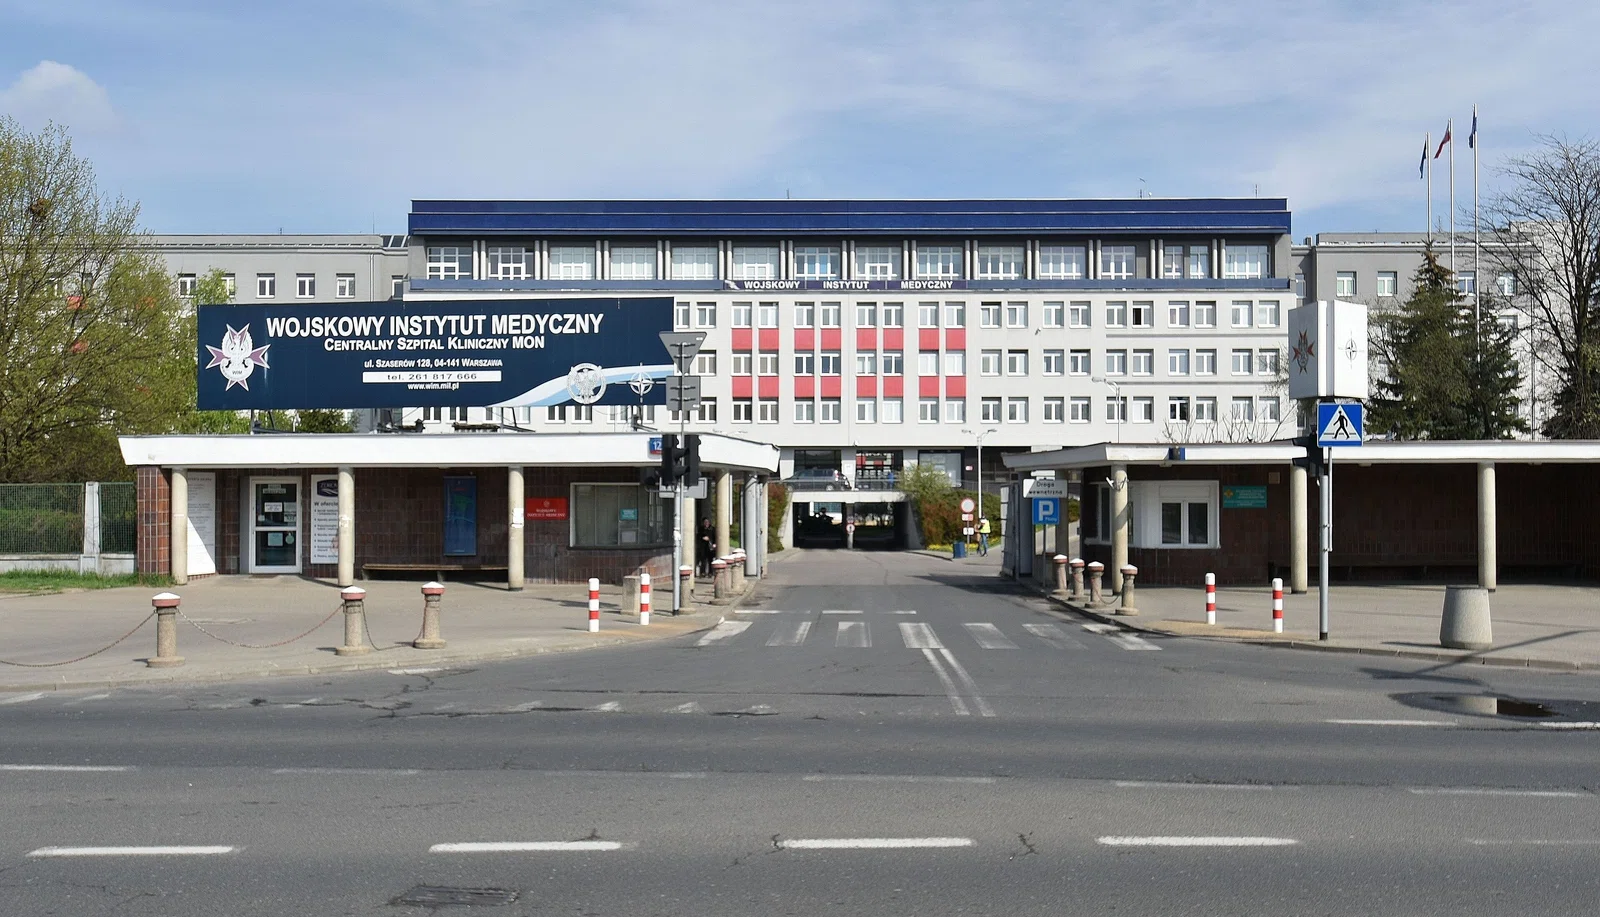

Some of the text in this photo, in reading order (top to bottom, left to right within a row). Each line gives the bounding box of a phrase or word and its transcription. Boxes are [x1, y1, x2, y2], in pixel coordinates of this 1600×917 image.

[744, 281, 953, 289] WOJSKOWY INSTYTUT MEDYCZNY
[266, 313, 604, 337] WOJSKOWY INSTYTUT MEDYCZNY
[324, 335, 545, 351] CENTRALNY SZPITAL KLINICZNY MON
[364, 357, 503, 369] ul. SZASERÓW 128, 04-141 WARSZAWA
[407, 382, 460, 391] www.wim.mil.pl
[1038, 500, 1054, 521] P
